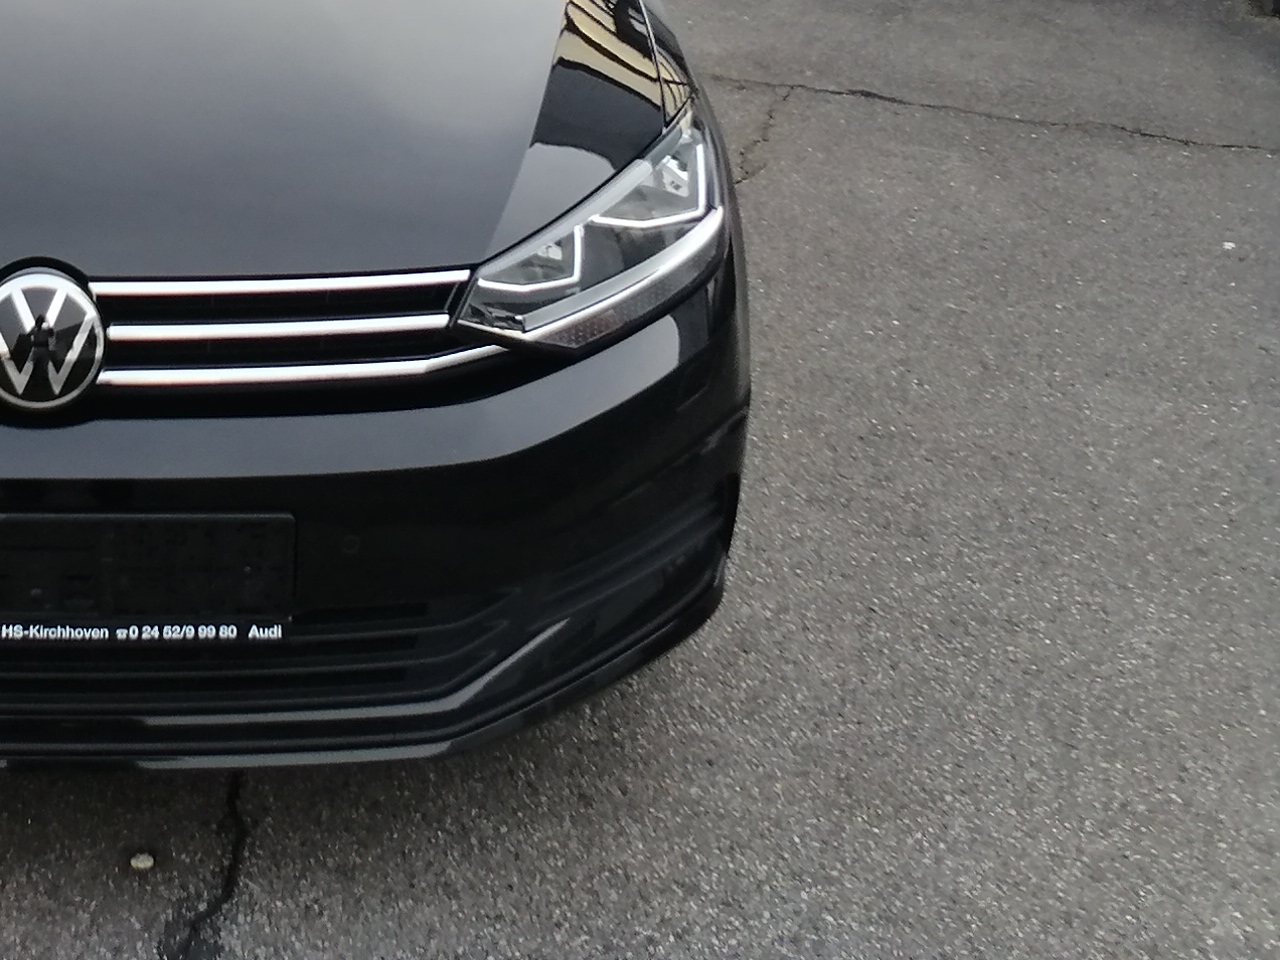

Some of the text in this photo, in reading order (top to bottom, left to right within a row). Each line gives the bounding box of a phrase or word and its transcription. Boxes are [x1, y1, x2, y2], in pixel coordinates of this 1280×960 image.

[1, 624, 109, 639] HS-Kirchhoven
[141, 625, 160, 639] 24
[248, 624, 282, 639] Audi
